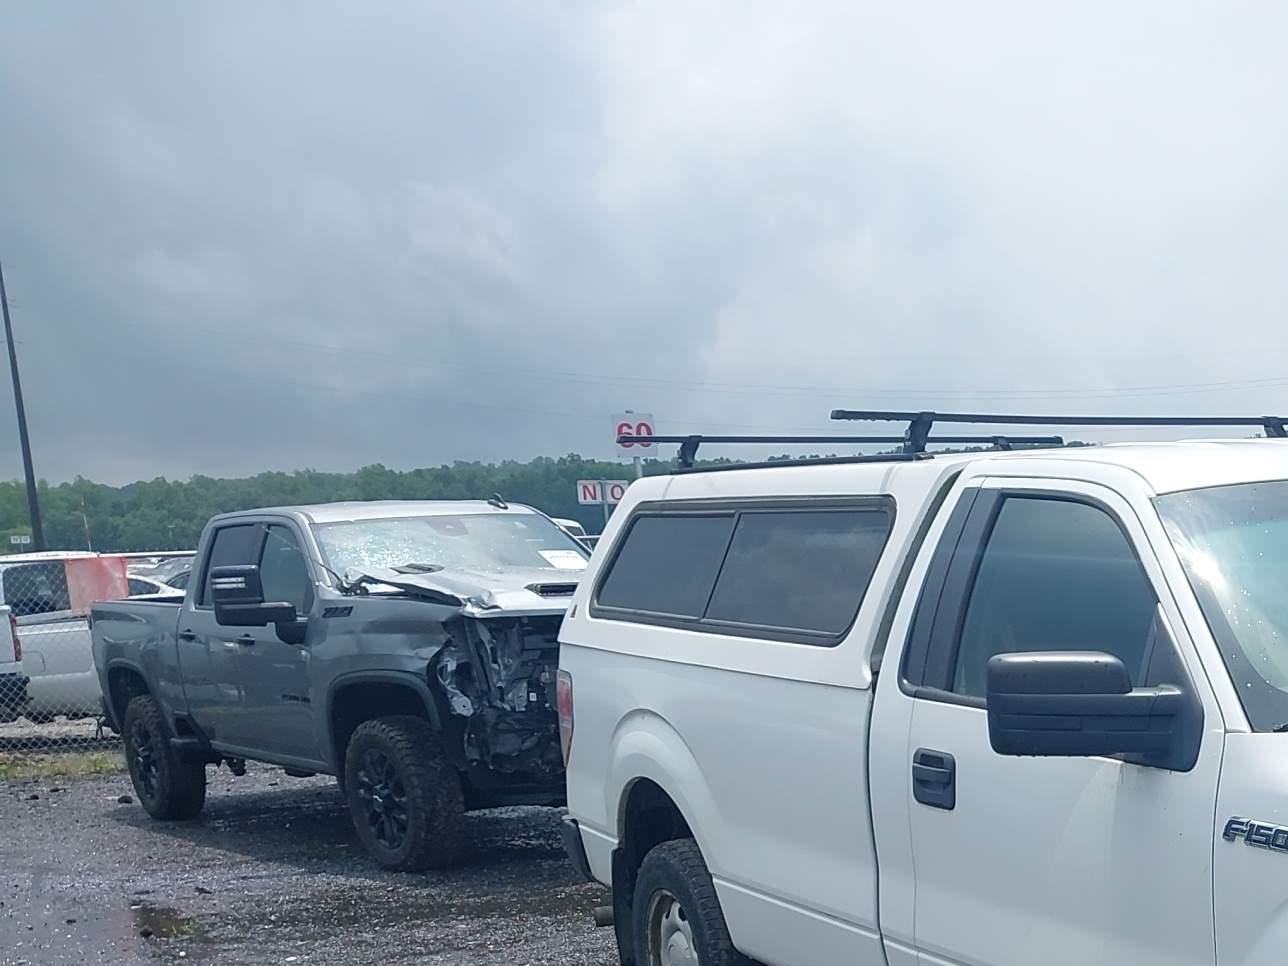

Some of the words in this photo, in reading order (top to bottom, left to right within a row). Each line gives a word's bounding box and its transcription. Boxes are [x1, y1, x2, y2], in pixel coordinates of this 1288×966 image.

[617, 422, 652, 448] 60
[582, 484, 597, 501] N
[610, 484, 625, 501] O
